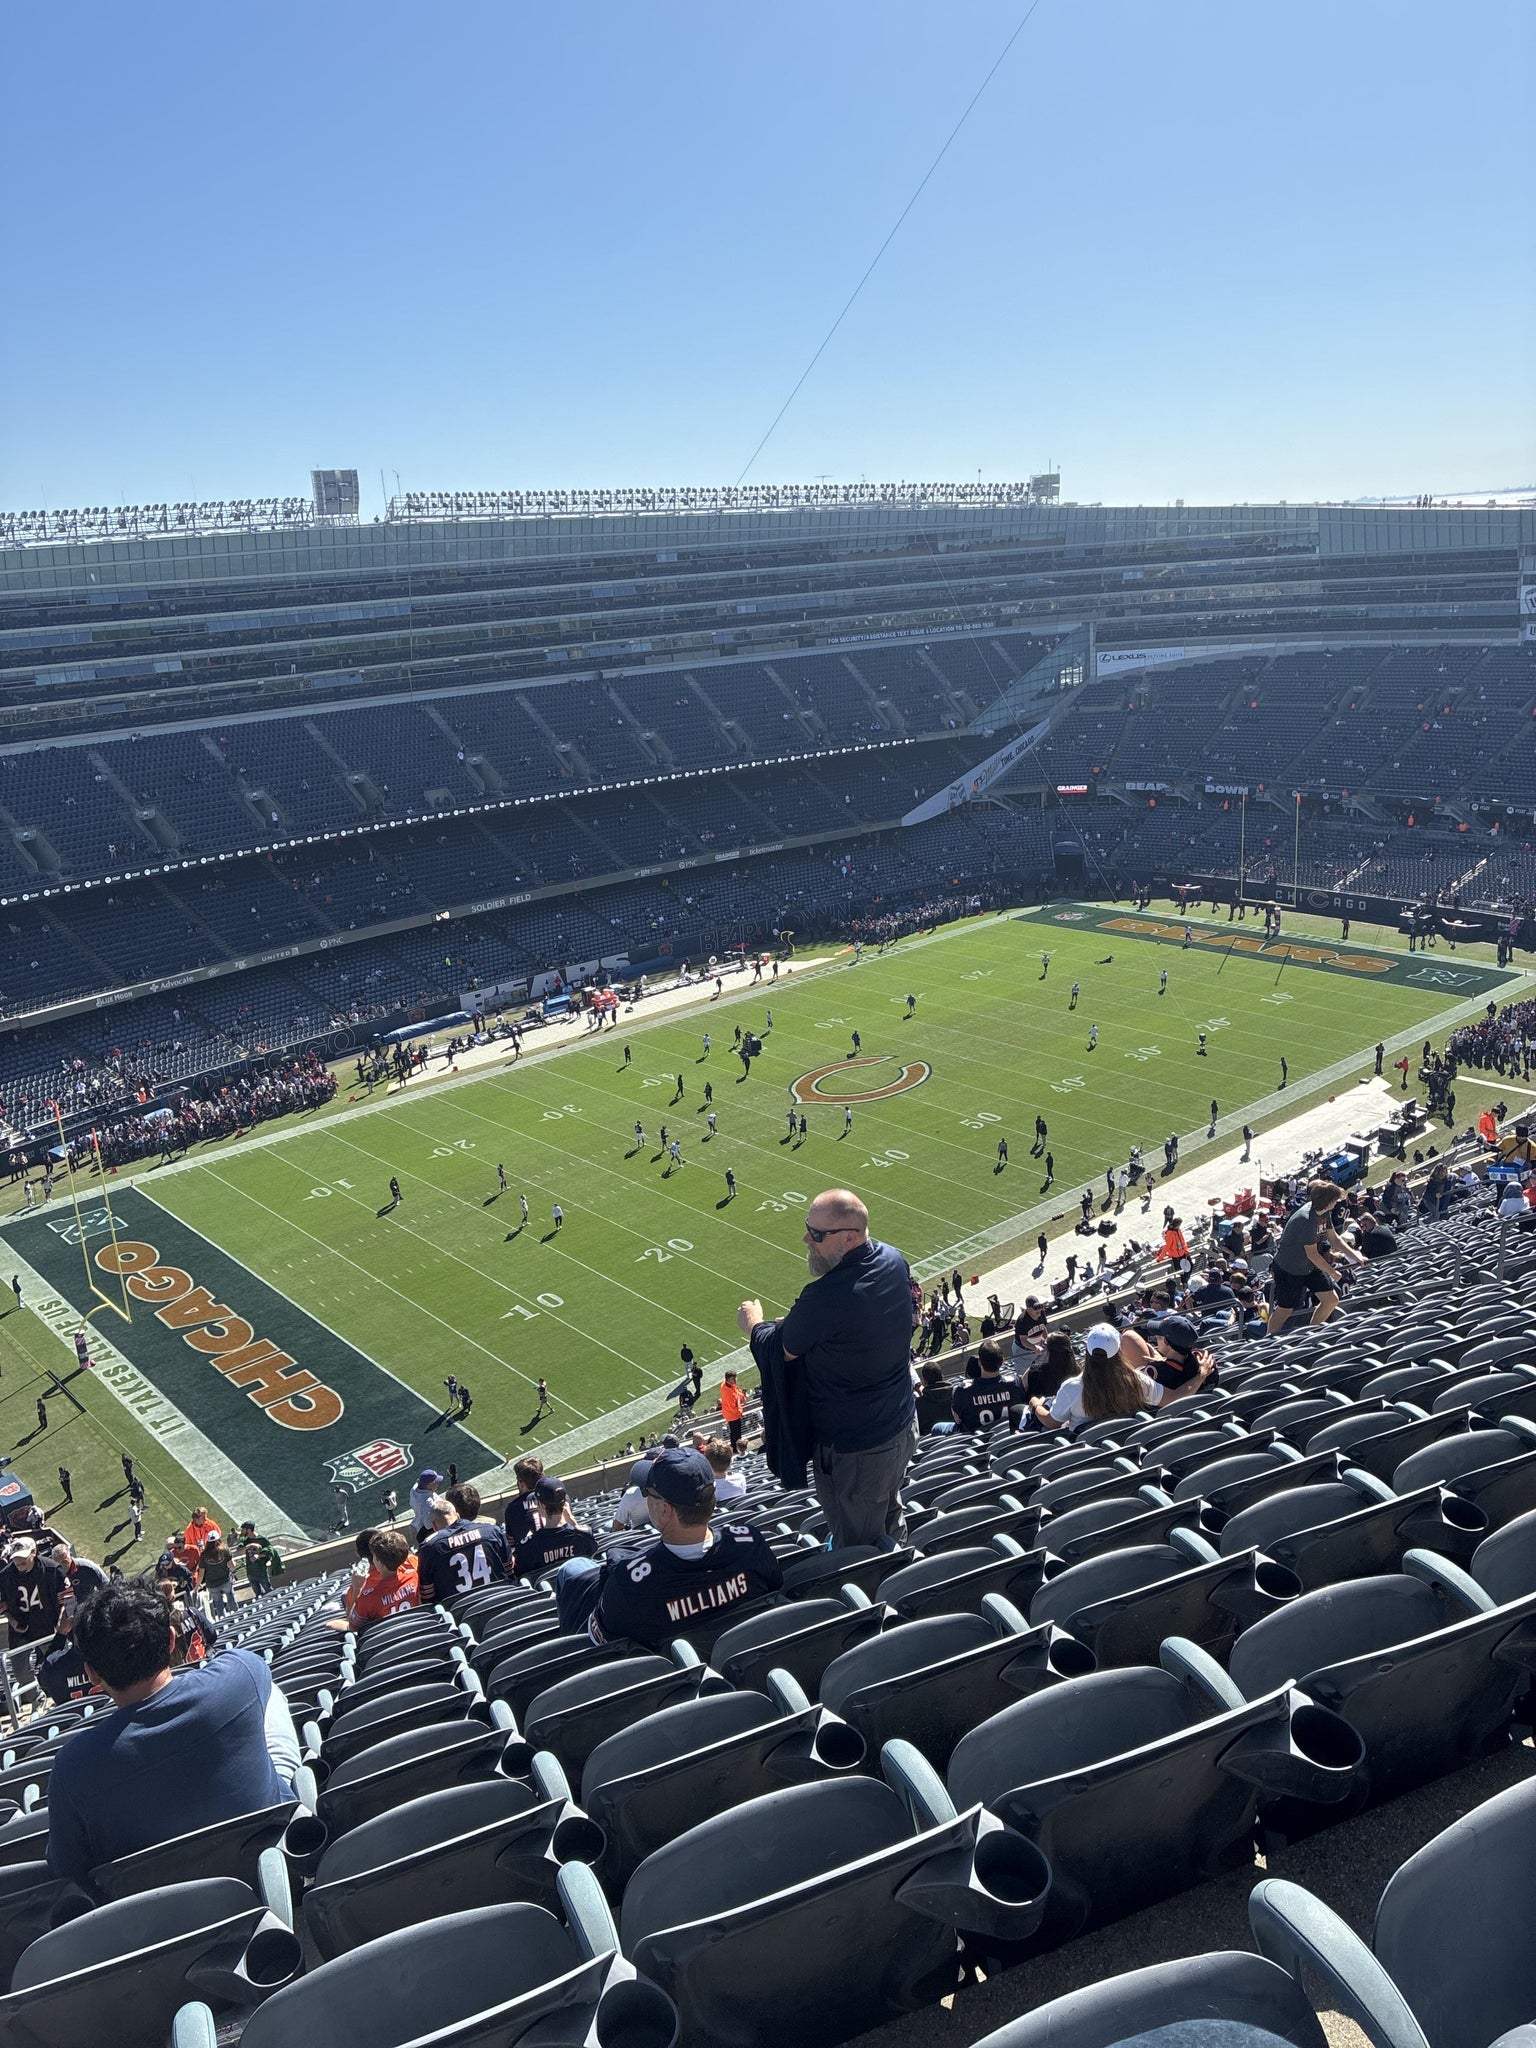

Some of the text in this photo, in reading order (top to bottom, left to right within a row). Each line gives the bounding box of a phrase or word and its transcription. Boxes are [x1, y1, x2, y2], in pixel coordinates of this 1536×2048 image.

[1112, 652, 1147, 661] LEXUS
[1057, 784, 1088, 792] GRAINGER
[1205, 784, 1249, 795] DOWN
[749, 843, 785, 856] ticketmaster
[685, 859, 698, 868] PNC
[471, 893, 532, 913] SOLDIER FIELD
[328, 936, 344, 946] PNC
[1096, 917, 1400, 973] BEARS
[261, 950, 291, 962] UNITED
[160, 974, 194, 989] Advocate
[96, 991, 133, 1008] BLUE MOON
[1261, 991, 1294, 1006] 10
[1196, 1018, 1230, 1032] 20
[1125, 1046, 1162, 1062] 30
[645, 1072, 676, 1088] 40
[1050, 1077, 1086, 1094] 40
[543, 1104, 583, 1121] 30
[959, 1112, 1002, 1130] 50
[433, 1139, 477, 1158] 20
[876, 1149, 911, 1169] 40
[309, 1177, 356, 1199] 10
[761, 1191, 809, 1213] 30
[656, 1237, 694, 1263] 20
[36, 1299, 71, 1320] US
[520, 1292, 564, 1320] 10
[94, 1240, 344, 1430] CHICAGO
[102, 1364, 159, 1416] TAKES
[972, 1391, 1011, 1406] LOVELAND
[150, 1415, 187, 1438] IT
[357, 1442, 406, 1477] NFL
[448, 1528, 482, 1549] PAYTON
[728, 1525, 755, 1543] 18
[543, 1545, 575, 1564] ODUNZE
[450, 1544, 493, 1593] 34
[626, 1555, 652, 1583] 18
[17, 1584, 44, 1612] 34
[381, 1583, 416, 1606] WILLIAMS
[665, 1572, 749, 1623] WILLIAMS
[66, 1673, 91, 1689] WILL
